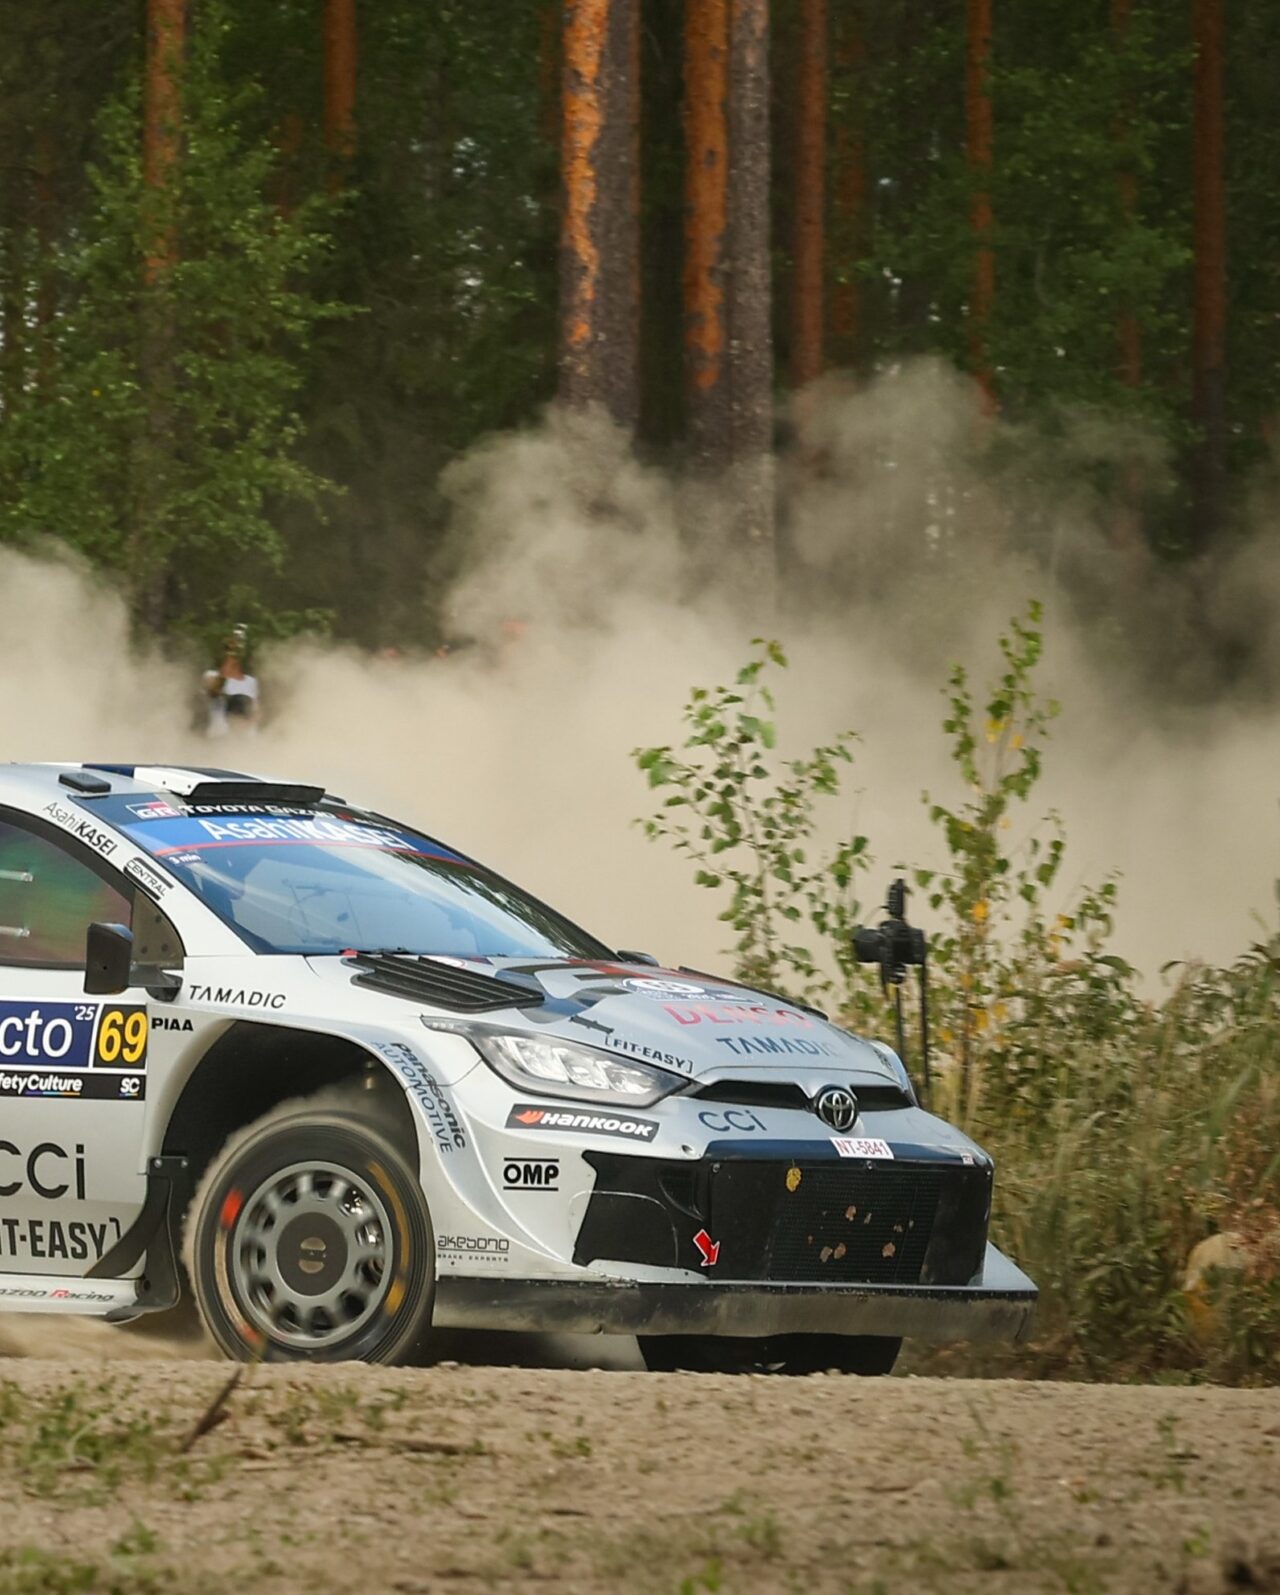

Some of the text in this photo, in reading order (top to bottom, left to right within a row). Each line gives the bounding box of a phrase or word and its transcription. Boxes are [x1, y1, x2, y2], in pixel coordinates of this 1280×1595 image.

[178, 804, 264, 814] TOYOTA
[42, 802, 118, 856] AsahiKASEI
[198, 817, 420, 852] AsahiKASEI
[126, 859, 167, 897] CENTRAL
[187, 985, 286, 1009] TAMADIC
[151, 1017, 194, 1032] PIAA
[98, 1011, 147, 1064] 69
[120, 1076, 140, 1095] SC
[370, 1041, 453, 1153] AUTOMOTIVE
[835, 1139, 891, 1156] NT-5841
[503, 1163, 559, 1185] OMP
[50, 1288, 116, 1302] Racing
